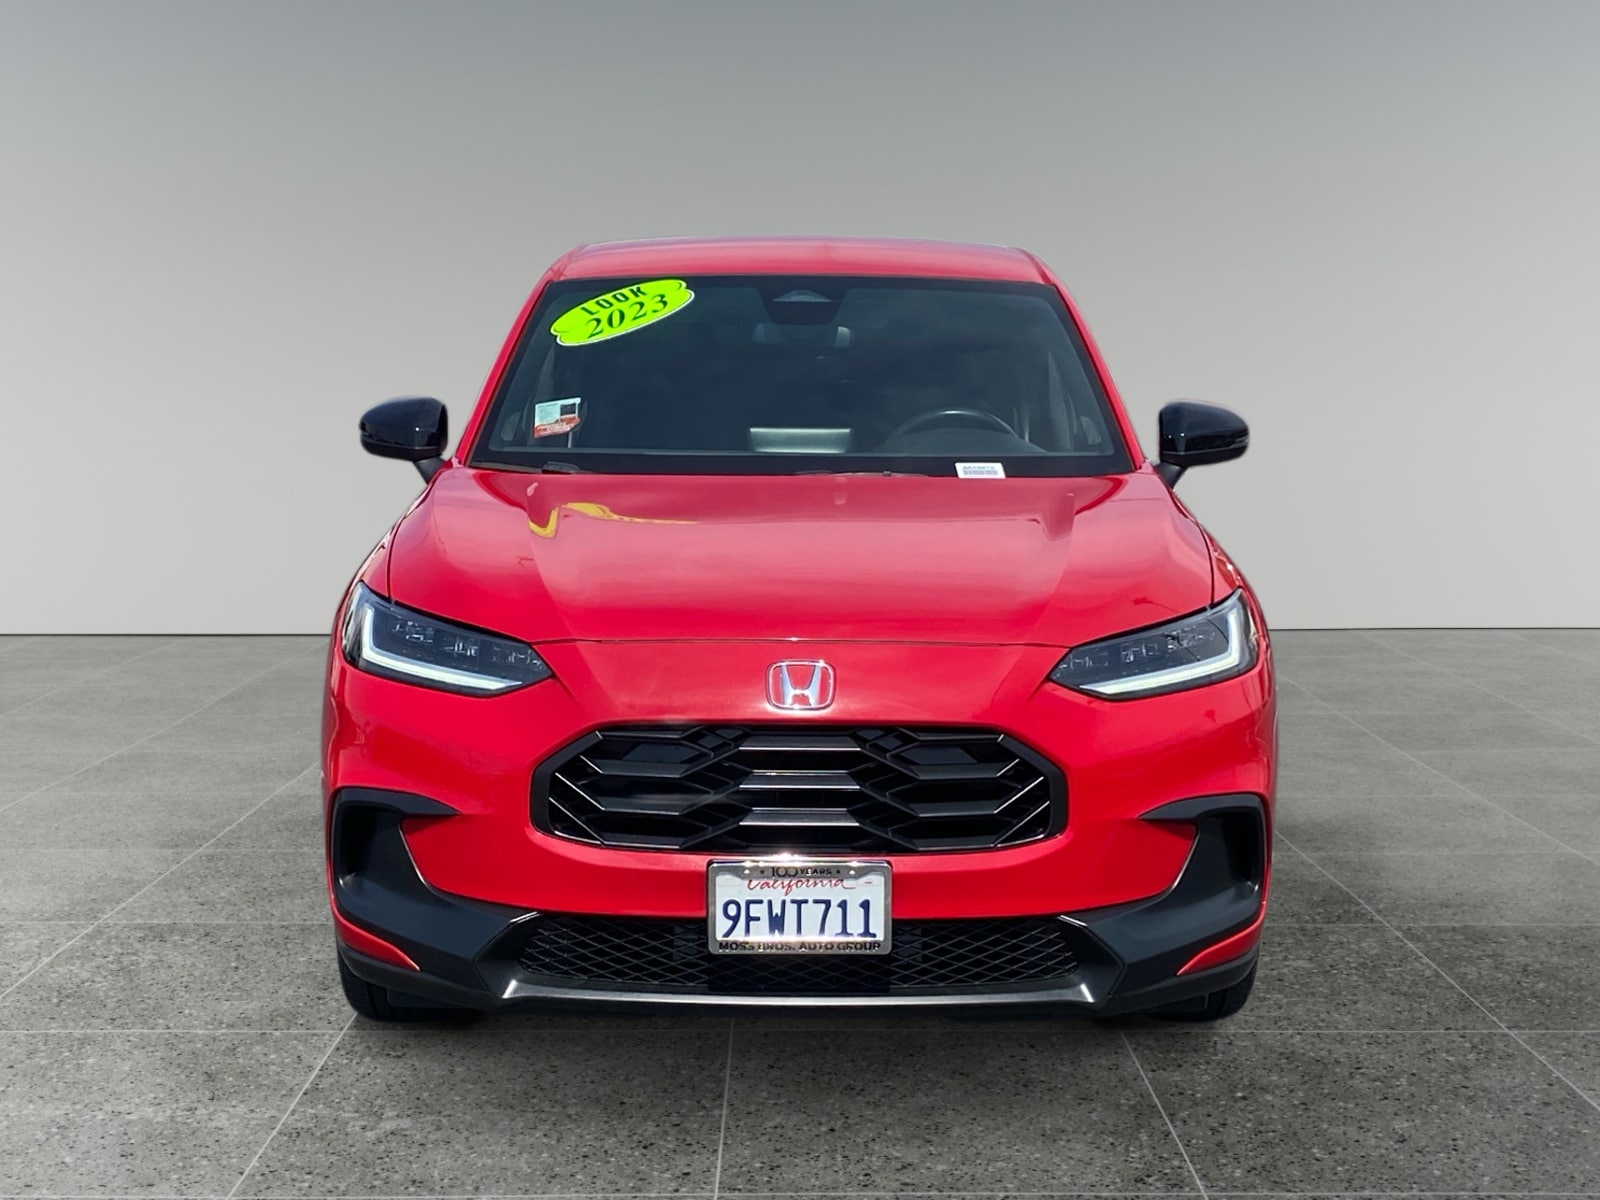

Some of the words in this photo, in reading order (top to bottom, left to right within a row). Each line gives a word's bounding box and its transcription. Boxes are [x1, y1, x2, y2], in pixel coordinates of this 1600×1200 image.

[579, 286, 648, 316] LOOK
[585, 293, 669, 339] 2023
[771, 866, 799, 878] 100
[799, 867, 832, 876] YEARS
[721, 898, 878, 939] 9FWT711
[718, 941, 755, 951] MOSS
[799, 941, 835, 951] AUTO
[836, 941, 881, 951] GROUP
